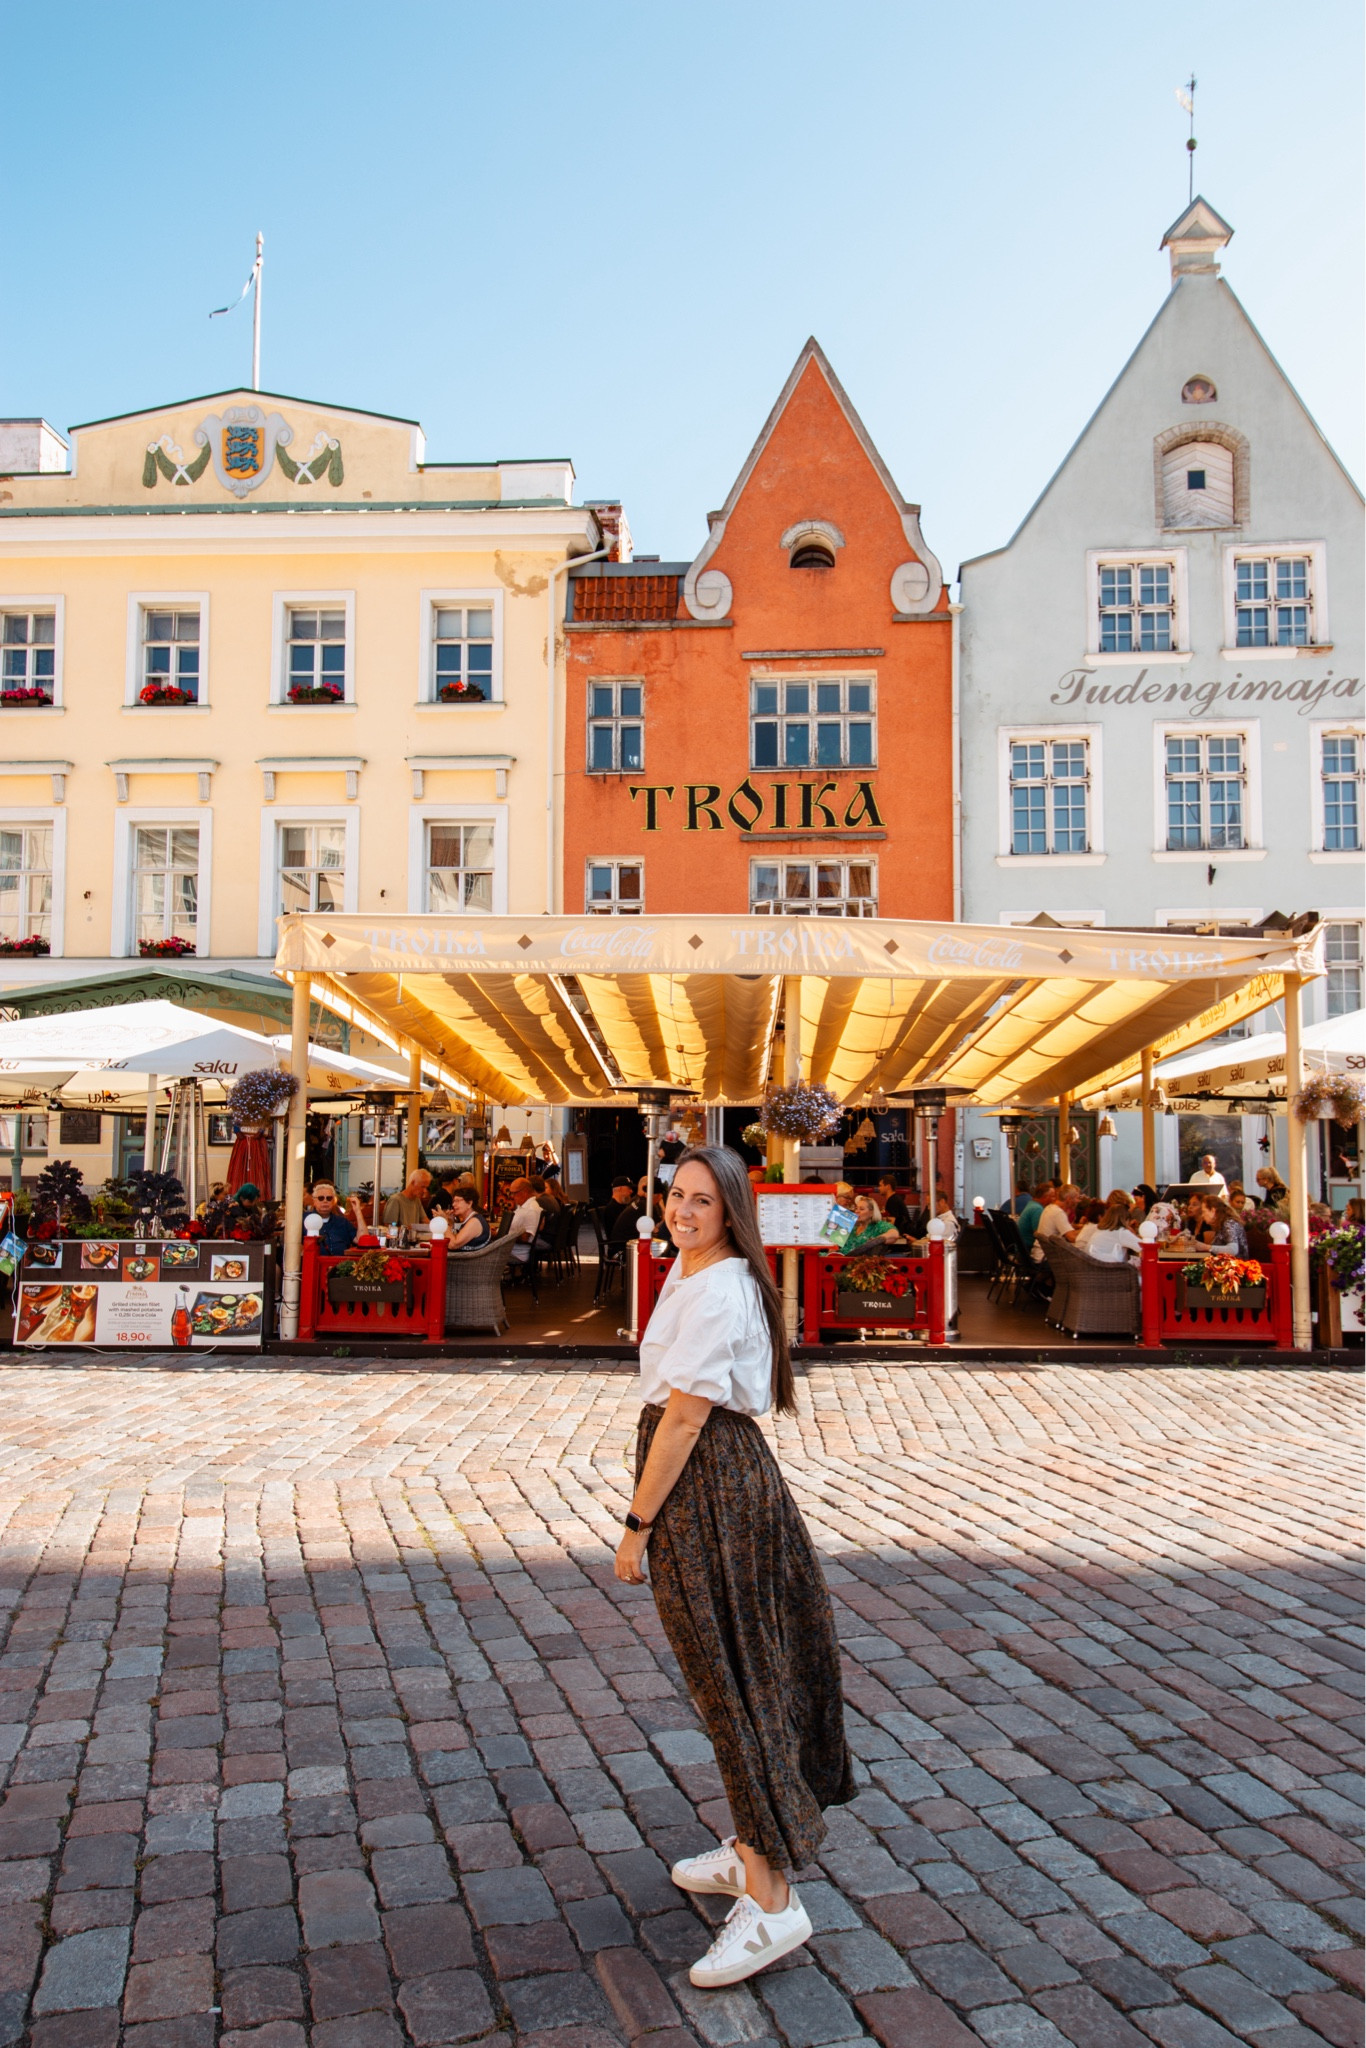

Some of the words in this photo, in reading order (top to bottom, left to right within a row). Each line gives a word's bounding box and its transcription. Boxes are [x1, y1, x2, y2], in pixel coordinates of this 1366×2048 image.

[1050, 668, 1365, 716] Tudengimaja
[629, 776, 887, 833] TROIKA
[363, 927, 488, 957] TROIKA
[731, 928, 856, 958] TROIKA
[1102, 946, 1225, 976] TROIKA
[193, 1060, 239, 1075] saku
[1230, 1064, 1245, 1082] saku
[1267, 1056, 1285, 1074] saku
[354, 1285, 382, 1293] TROIKA
[1211, 1294, 1241, 1302] TROIKA
[862, 1300, 892, 1309] TROIKA
